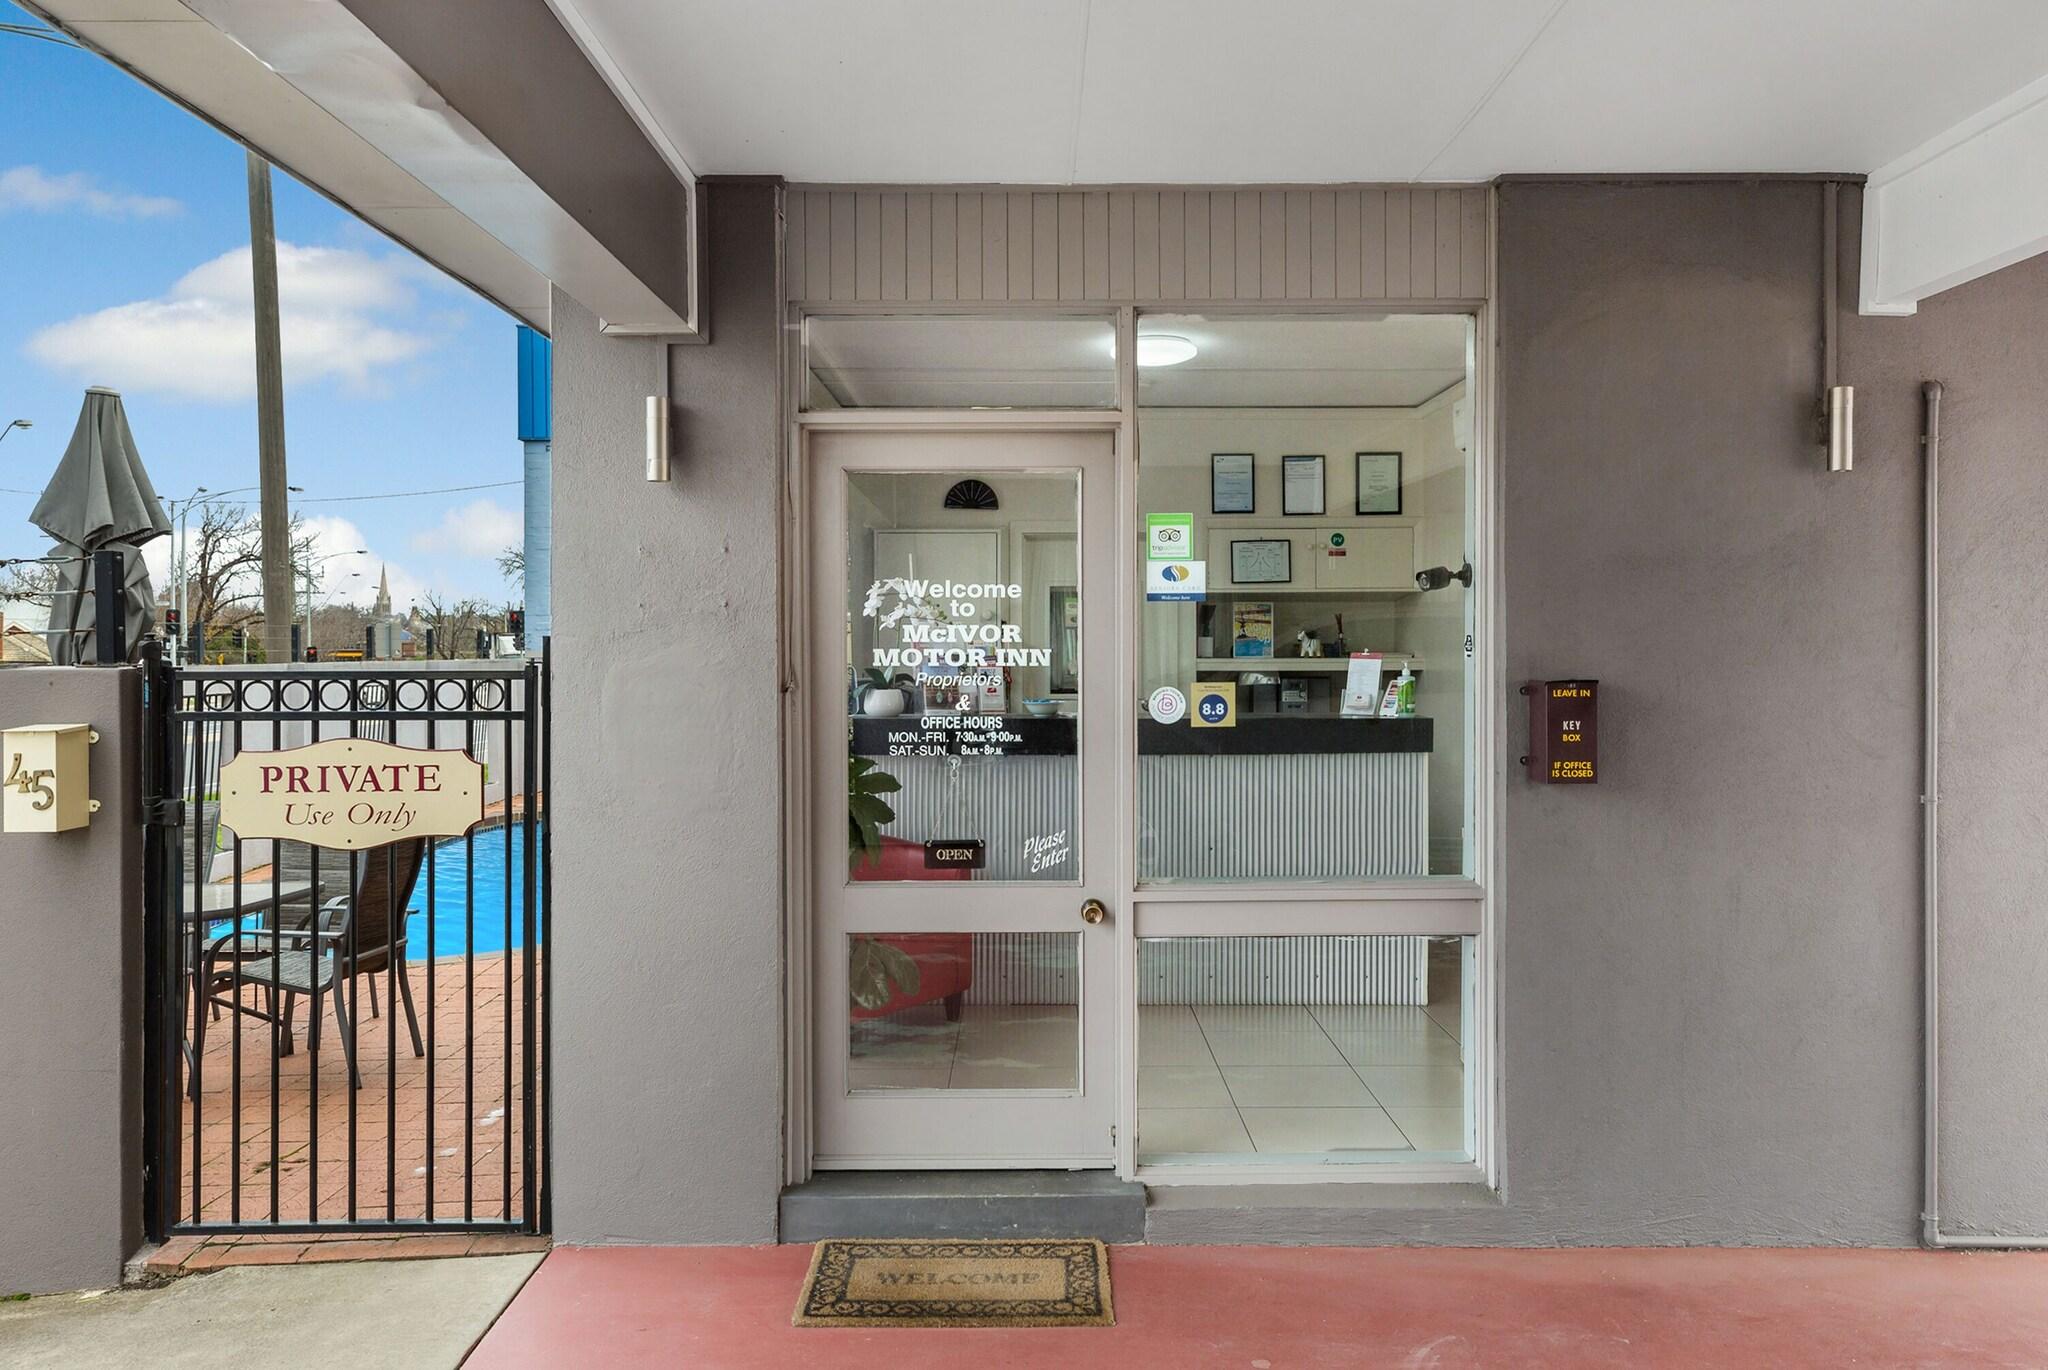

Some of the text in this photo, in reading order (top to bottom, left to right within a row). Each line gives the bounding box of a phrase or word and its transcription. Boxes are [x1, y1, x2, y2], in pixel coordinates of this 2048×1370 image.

[904, 580, 1022, 598] Welcome
[950, 600, 975, 617] to
[902, 625, 1022, 643] McIVOR
[872, 649, 1052, 667] MOTOR INN
[915, 672, 1002, 689] Proprietors
[1553, 689, 1577, 697] LEAVE
[955, 694, 971, 710] &
[1202, 703, 1224, 715] 8.8
[920, 716, 1003, 729] OFFICE HOURS
[1563, 720, 1581, 731] KEY
[888, 732, 949, 743] MON.-FRI.
[889, 745, 949, 756] SAT.-SUN.
[4, 753, 55, 811] 45
[259, 764, 442, 793] PRIVATE
[285, 802, 416, 832] Use Only
[1024, 830, 1066, 860] Please
[936, 849, 973, 861] OPEN
[1031, 847, 1068, 873] Enter
[878, 1272, 1040, 1285] WELCOME
